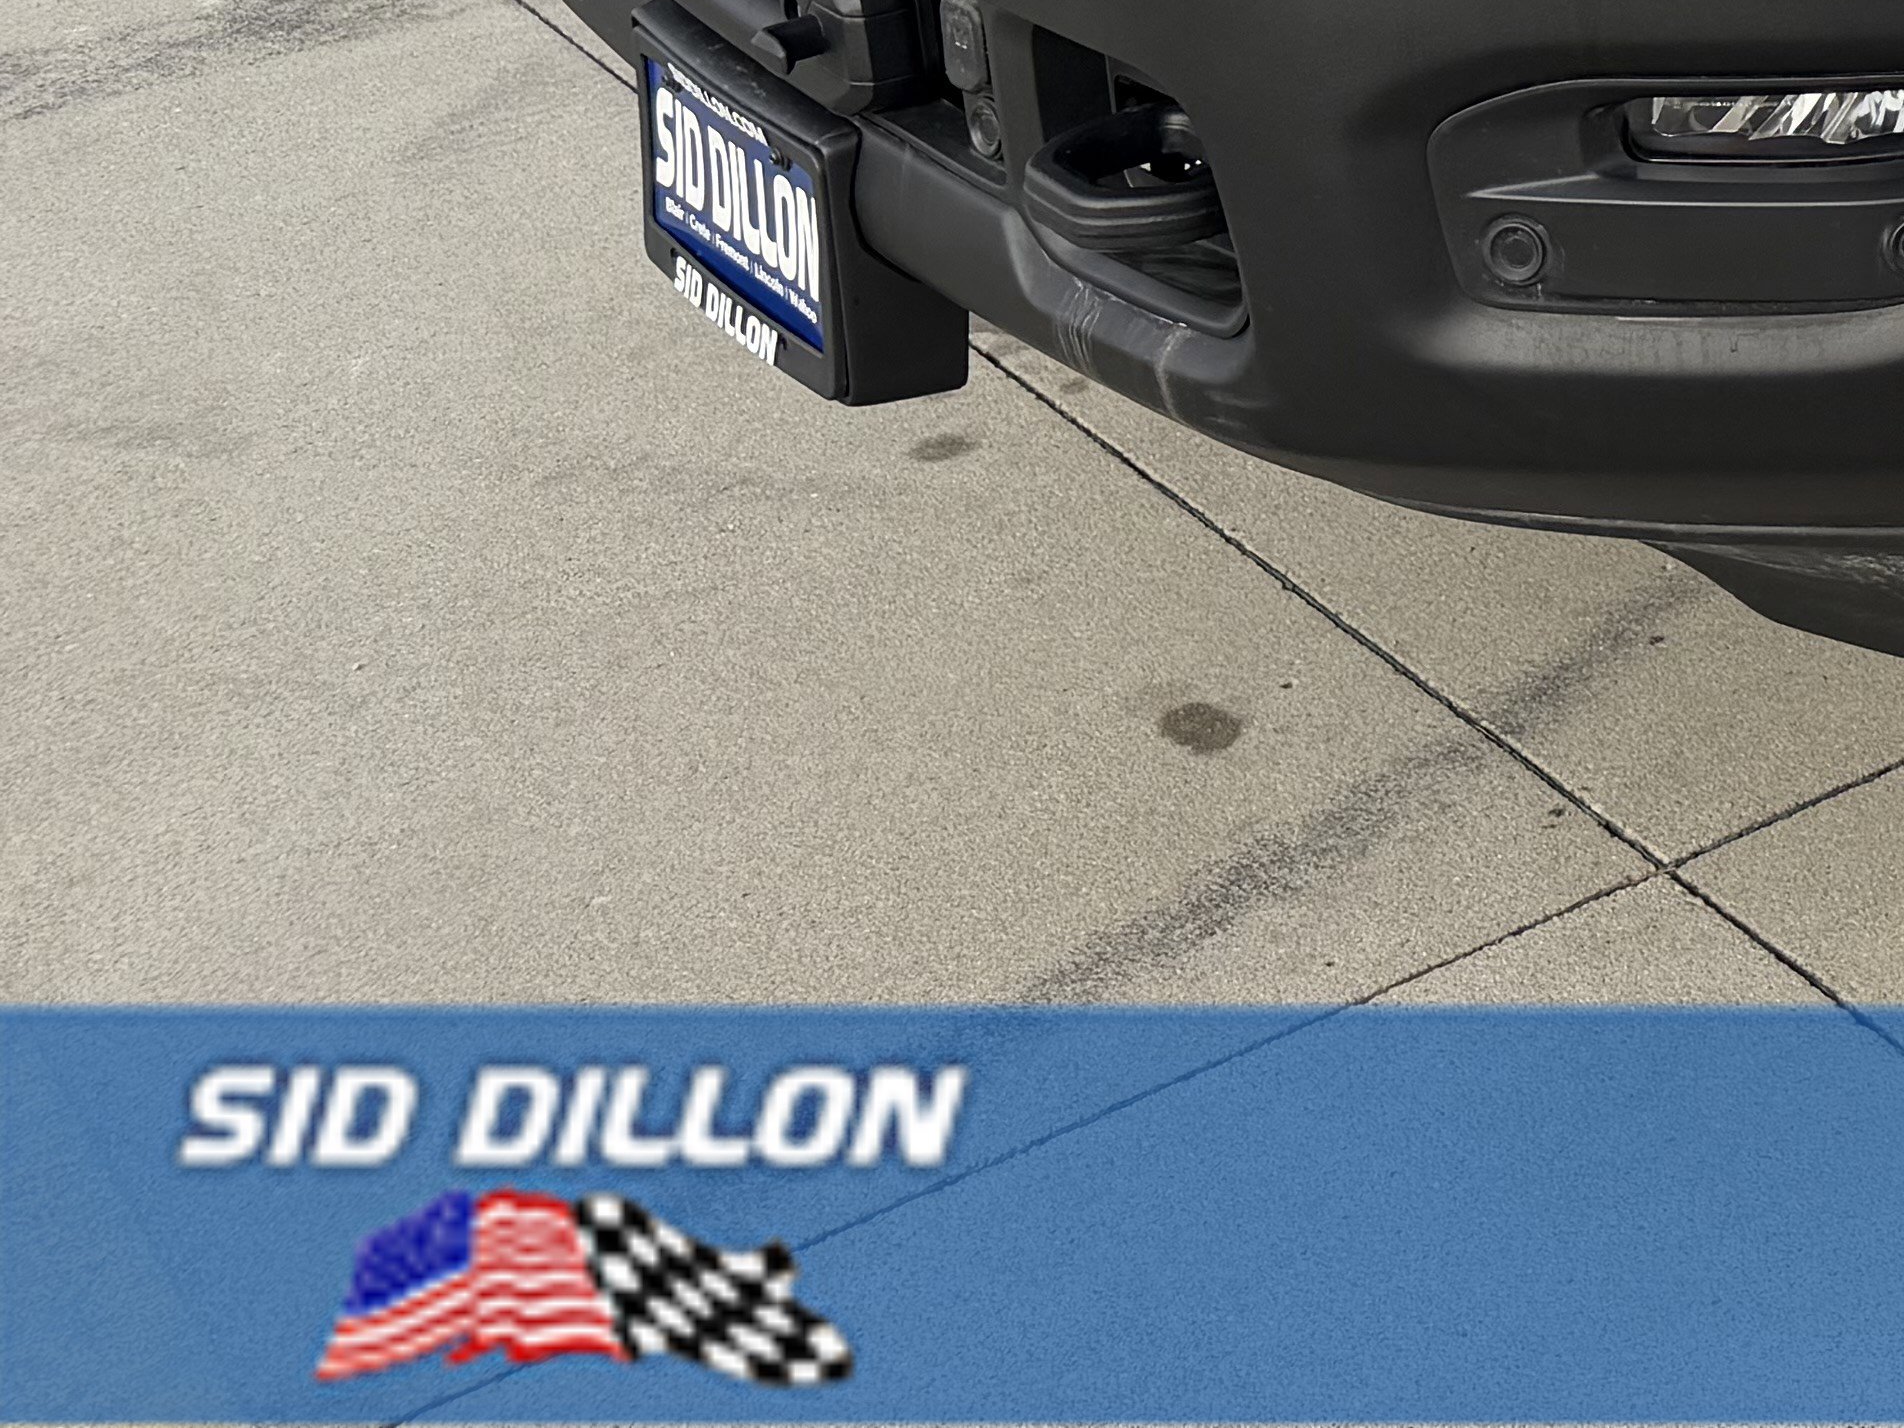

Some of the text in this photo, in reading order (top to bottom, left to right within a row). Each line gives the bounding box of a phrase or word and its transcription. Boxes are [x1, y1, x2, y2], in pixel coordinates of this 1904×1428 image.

[655, 86, 820, 304] SID DILLON
[673, 255, 778, 367] SID DILLON
